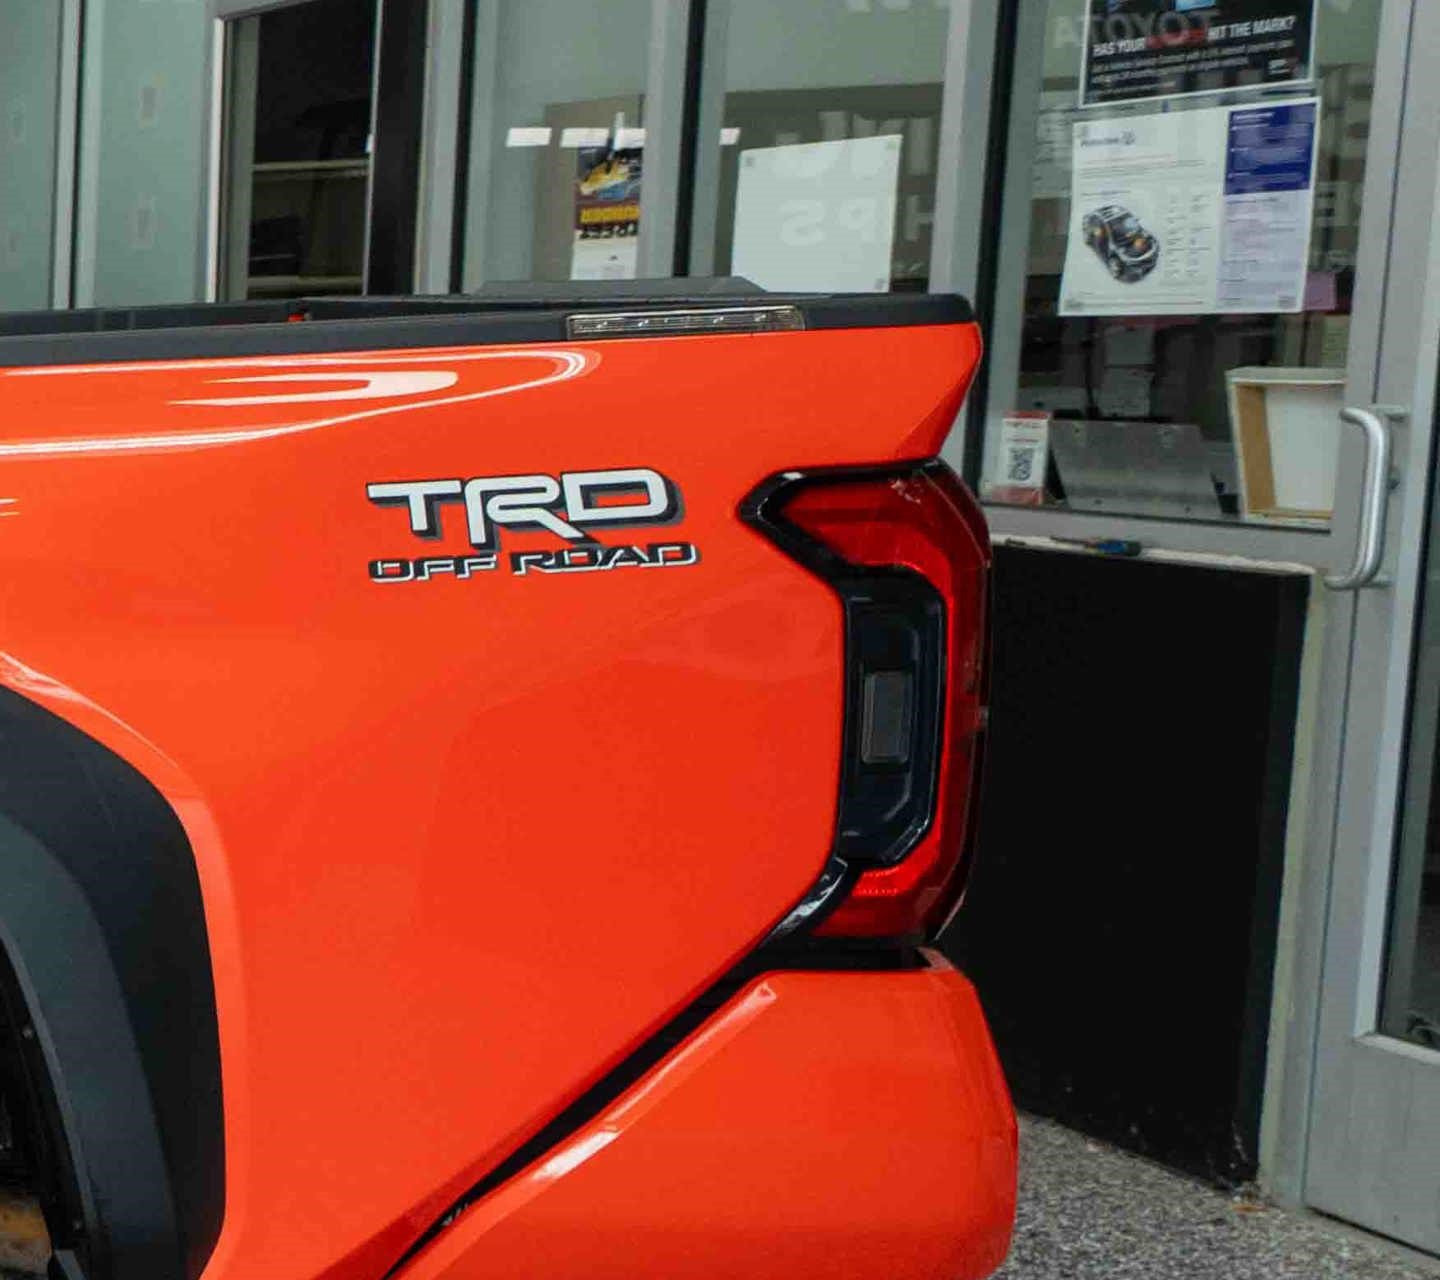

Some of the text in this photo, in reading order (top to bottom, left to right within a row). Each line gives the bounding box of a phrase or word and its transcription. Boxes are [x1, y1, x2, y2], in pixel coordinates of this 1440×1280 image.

[366, 467, 682, 550] TRD
[367, 542, 700, 584] OFF ROAD
